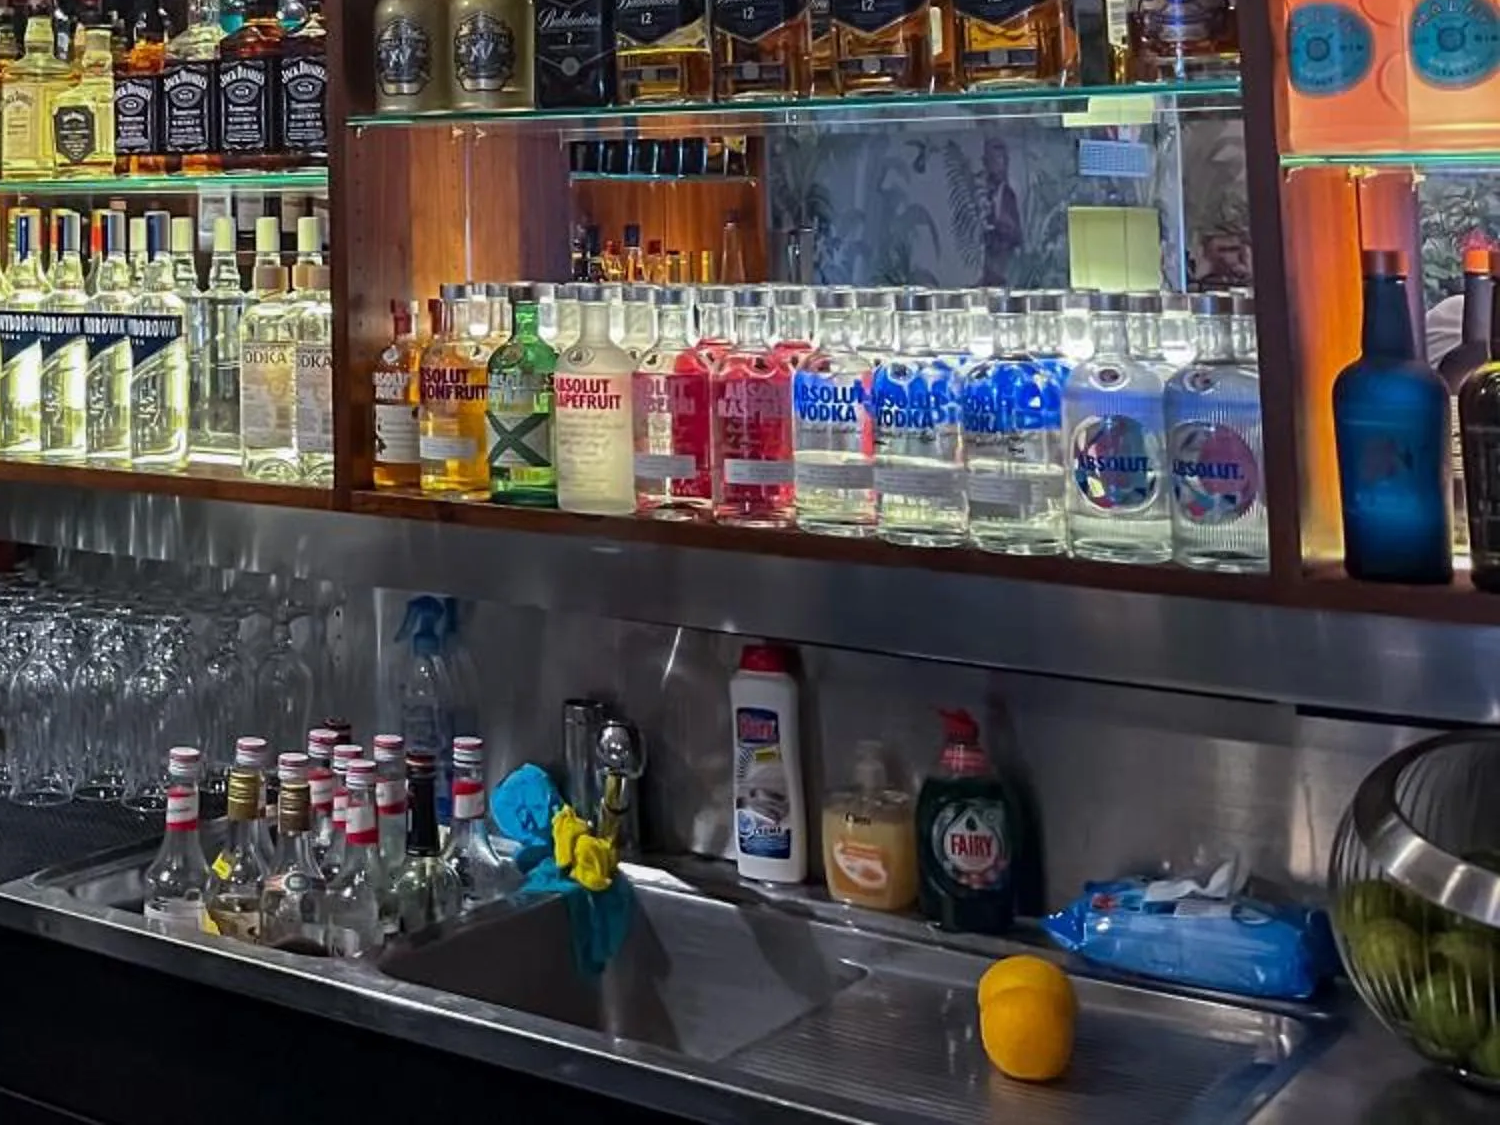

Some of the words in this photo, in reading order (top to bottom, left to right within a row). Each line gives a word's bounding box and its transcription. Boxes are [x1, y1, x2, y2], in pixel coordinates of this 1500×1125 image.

[640, 12, 653, 25] 12
[742, 5, 756, 21] 12
[799, 404, 857, 422] VODKA
[951, 833, 994, 858] FAIRY
